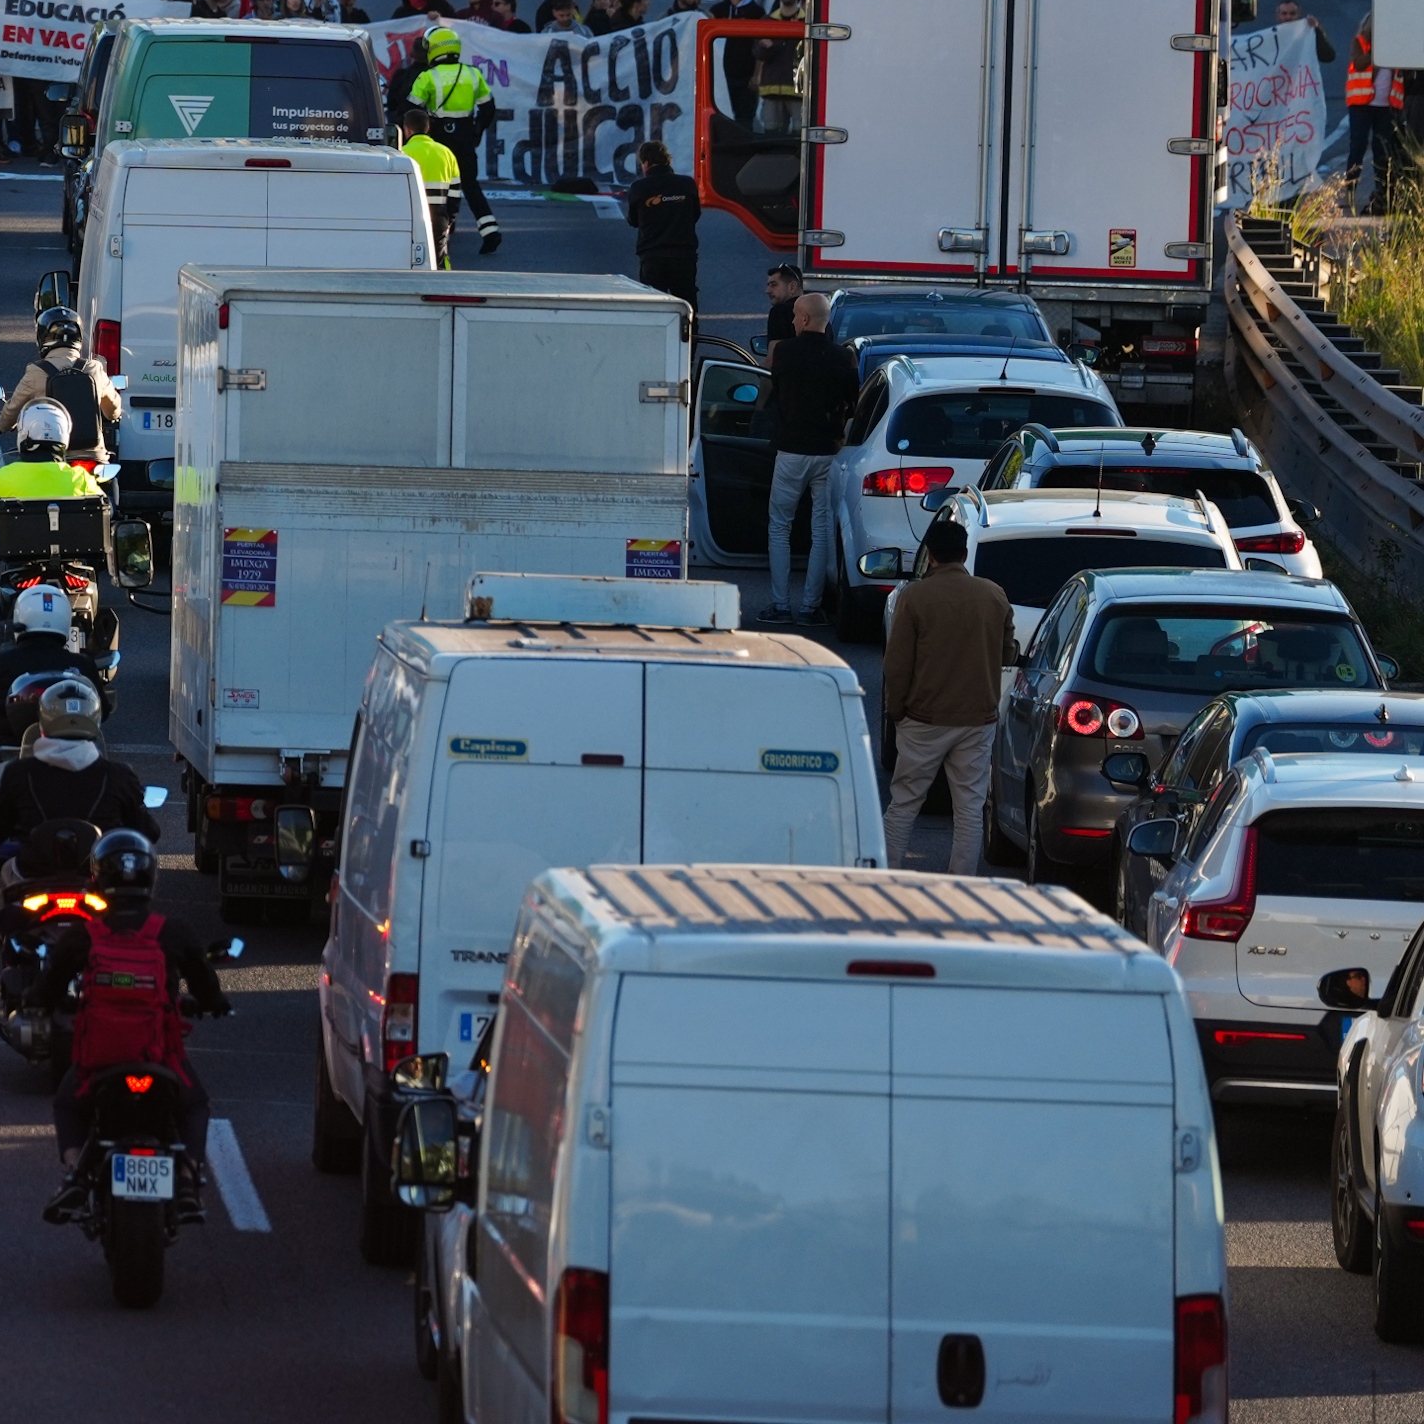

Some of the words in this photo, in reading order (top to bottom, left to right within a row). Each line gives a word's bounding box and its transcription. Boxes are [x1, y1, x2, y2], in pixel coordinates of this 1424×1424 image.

[2, 24, 35, 45] EN
[0, 49, 53, 64] Defensem
[272, 105, 350, 120] Impulsamos
[272, 121, 288, 131] tus
[289, 121, 335, 134] proyectos
[336, 122, 349, 132] de
[141, 373, 177, 384] Alquile
[236, 541, 265, 549] PUERTAS
[230, 559, 269, 569] IMEXGA
[238, 569, 262, 580] 1979
[634, 567, 673, 578] IMEXGA
[126, 1158, 170, 1177] 8605
[126, 1176, 158, 1194] NMX
